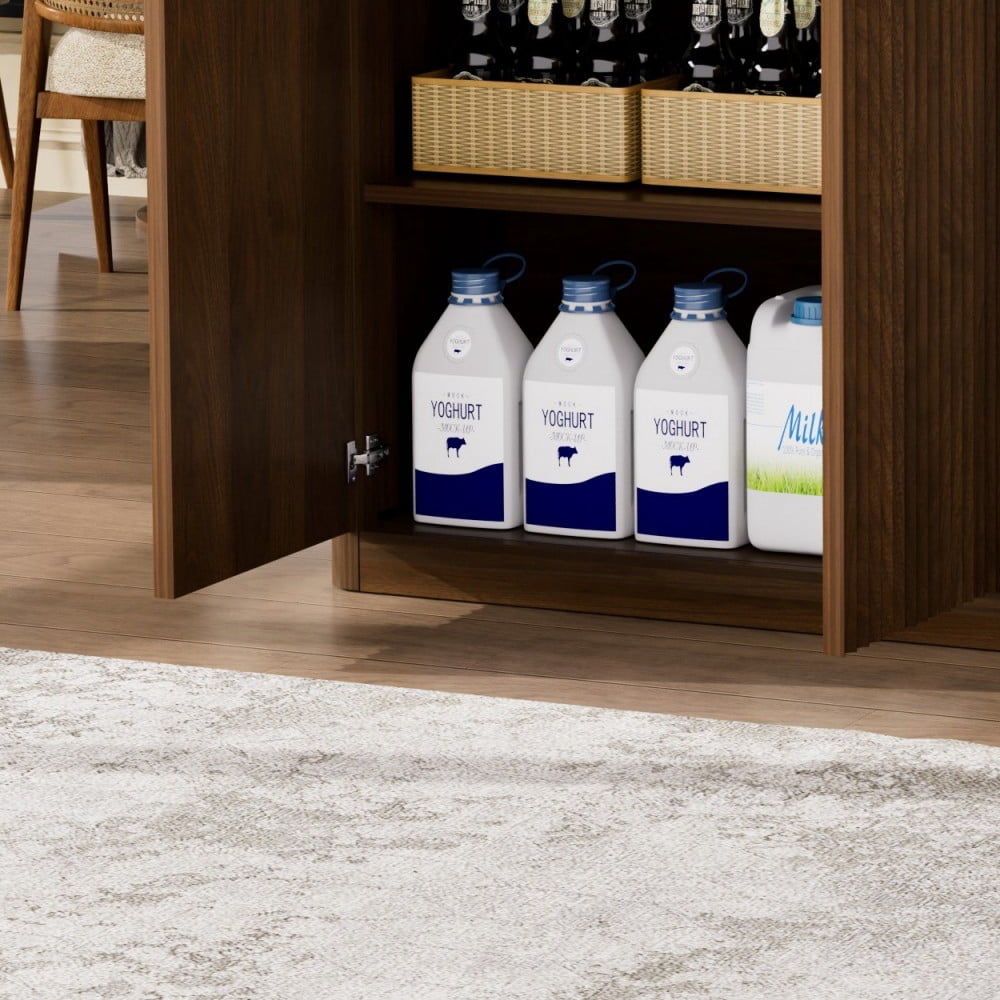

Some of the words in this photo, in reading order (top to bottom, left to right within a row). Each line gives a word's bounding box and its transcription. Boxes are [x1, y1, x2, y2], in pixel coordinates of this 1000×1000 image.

[431, 400, 482, 421] YOGHURT
[542, 408, 595, 430] YOGHURT
[654, 418, 707, 439] YOGHURT
[778, 404, 823, 451] Milk
